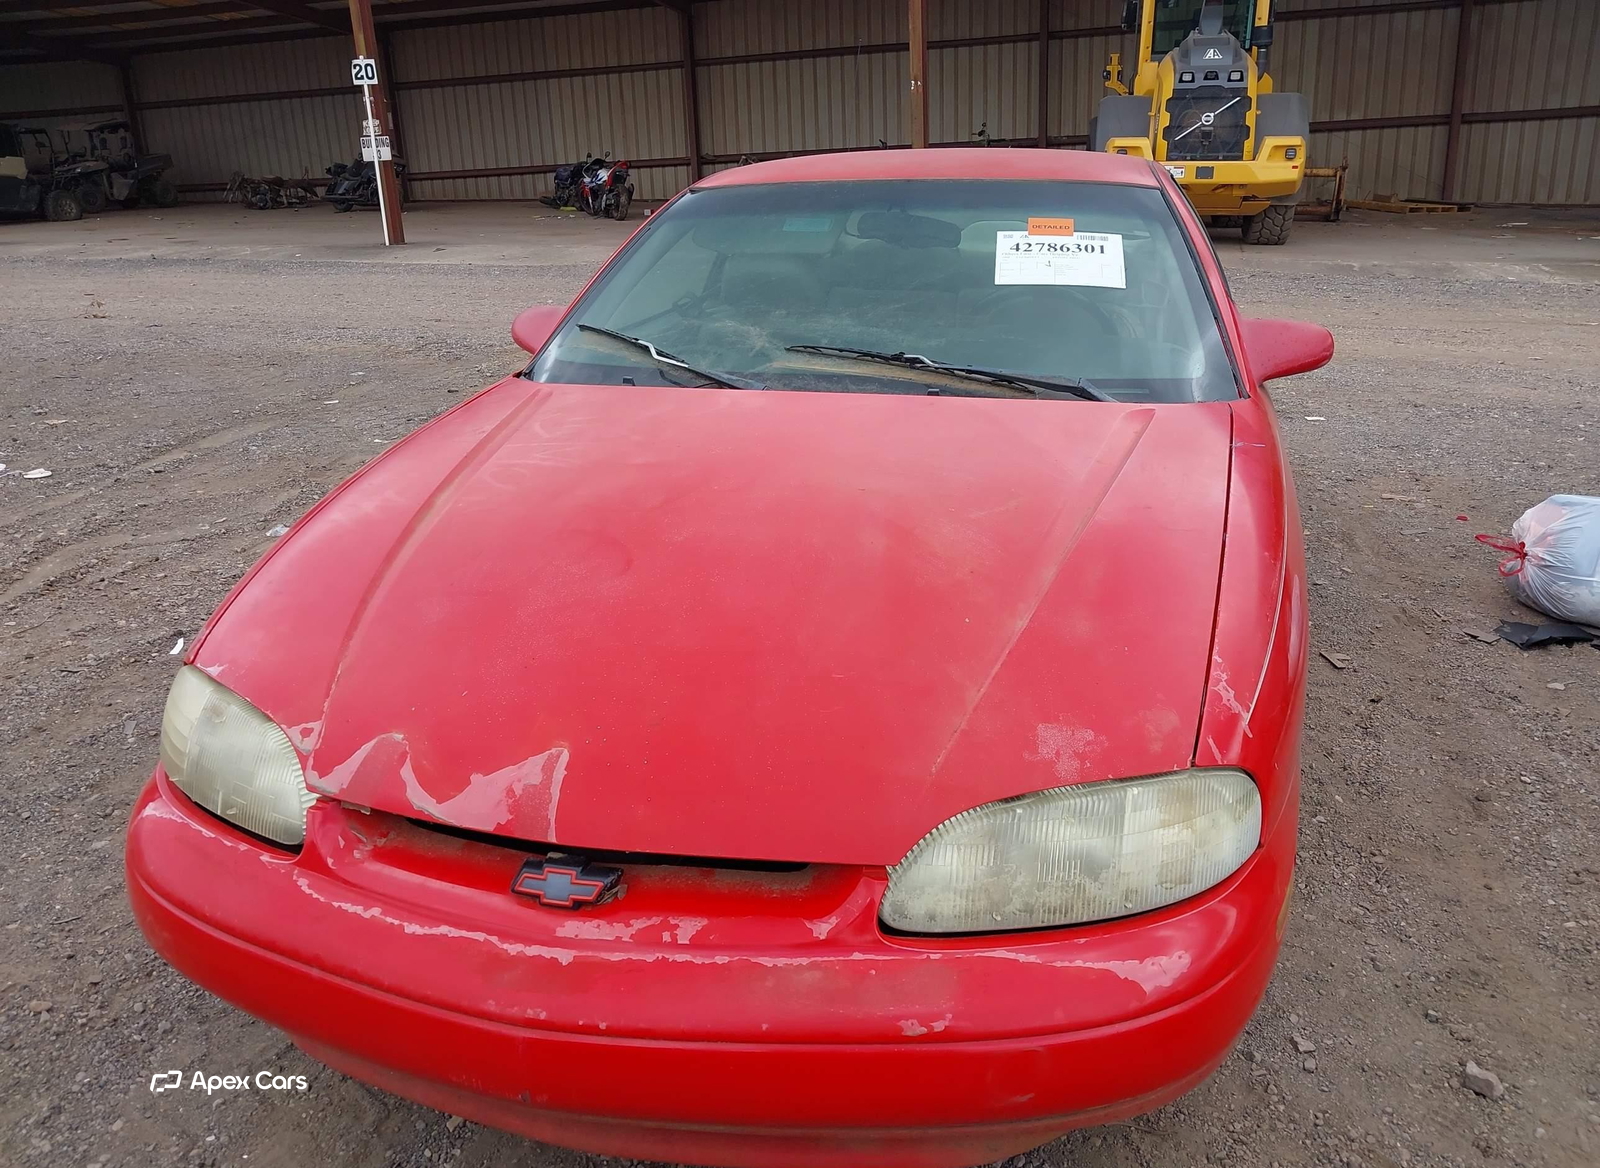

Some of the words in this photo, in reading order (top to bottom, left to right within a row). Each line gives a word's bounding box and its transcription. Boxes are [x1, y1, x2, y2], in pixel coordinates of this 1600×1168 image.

[353, 63, 375, 80] 20
[361, 137, 390, 149] BUIDING
[1010, 242, 1105, 255] 42786301
